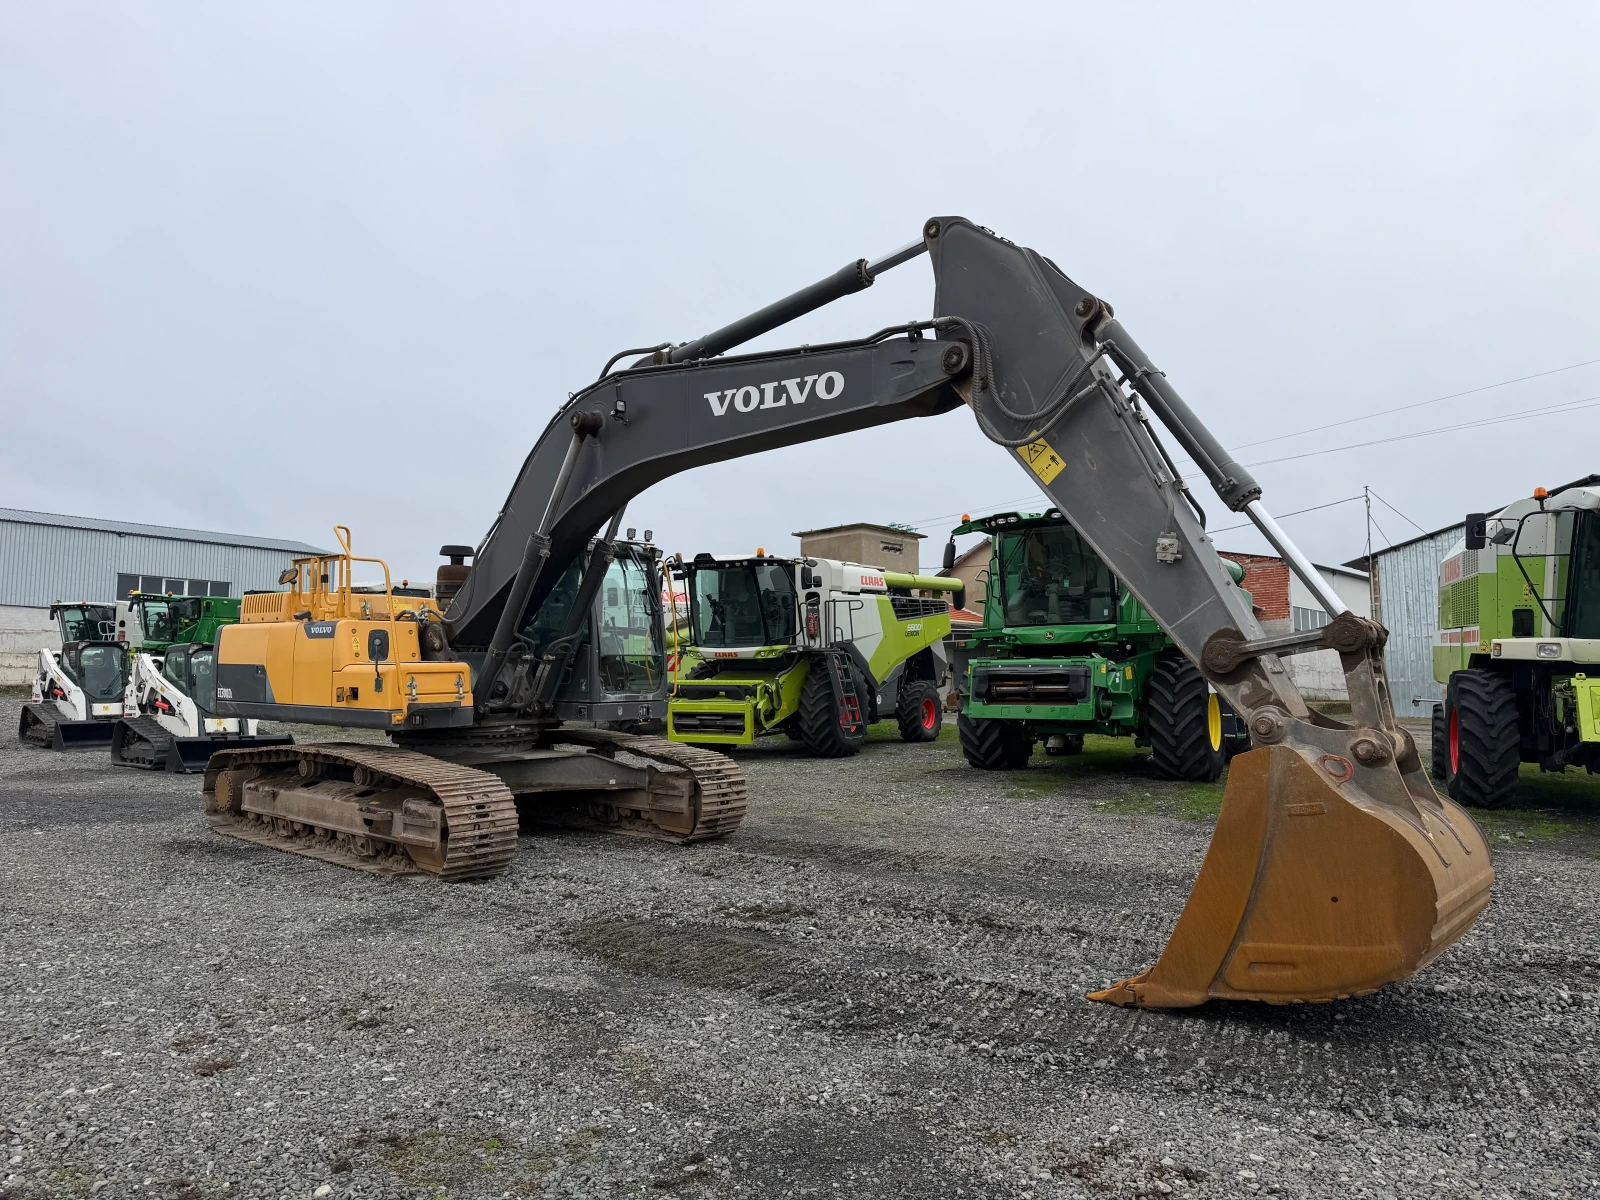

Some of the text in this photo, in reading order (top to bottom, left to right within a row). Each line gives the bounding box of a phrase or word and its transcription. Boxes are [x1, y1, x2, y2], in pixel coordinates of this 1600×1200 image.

[704, 371, 845, 416] VOLVO
[1445, 556, 1461, 582] CLAAS
[860, 575, 884, 587] CLAAS
[311, 626, 332, 634] VOLVO
[904, 630, 920, 638] LEXION
